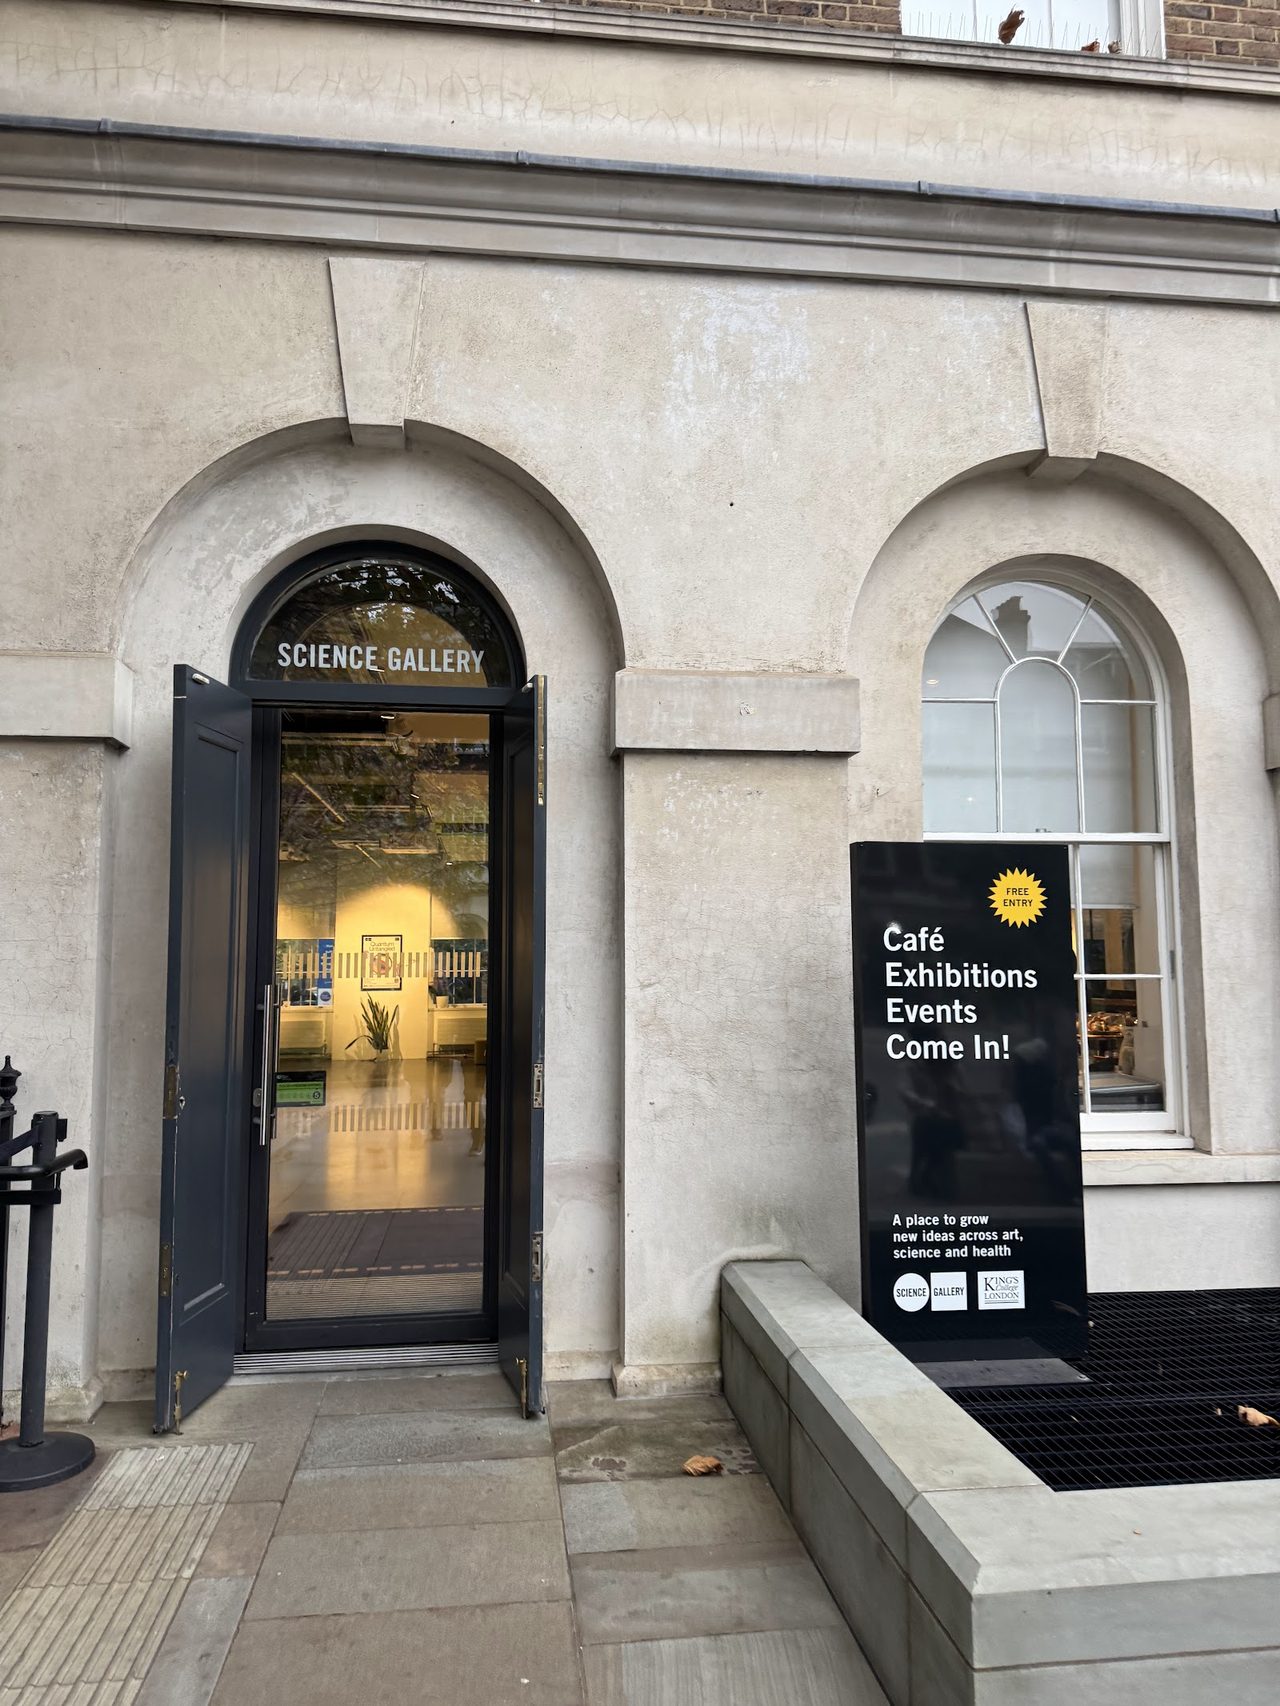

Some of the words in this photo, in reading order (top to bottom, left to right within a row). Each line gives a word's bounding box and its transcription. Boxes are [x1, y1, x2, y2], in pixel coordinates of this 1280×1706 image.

[278, 642, 378, 669] SCIENCE
[388, 647, 485, 673] GALLERY
[1006, 888, 1029, 896] FREE
[1003, 899, 1033, 907] ENTRY
[883, 926, 945, 952] Café
[885, 962, 1038, 988] Exhibitions
[886, 998, 978, 1024] Events
[886, 1034, 964, 1060] Come
[974, 1034, 1010, 1060] In!
[892, 1214, 902, 1226] A
[906, 1213, 940, 1228] place
[943, 1214, 956, 1226] to
[960, 1215, 989, 1228] grow
[893, 1232, 918, 1243] new
[922, 1230, 955, 1242] ideas
[959, 1230, 998, 1242] across
[1002, 1229, 1024, 1242] art,
[893, 1246, 941, 1259] science
[945, 1246, 968, 1258] and
[973, 1245, 1012, 1257] health
[896, 1288, 927, 1298] SCIENCE
[933, 1287, 965, 1297] GALLERY
[984, 1292, 1019, 1300] LONDON
